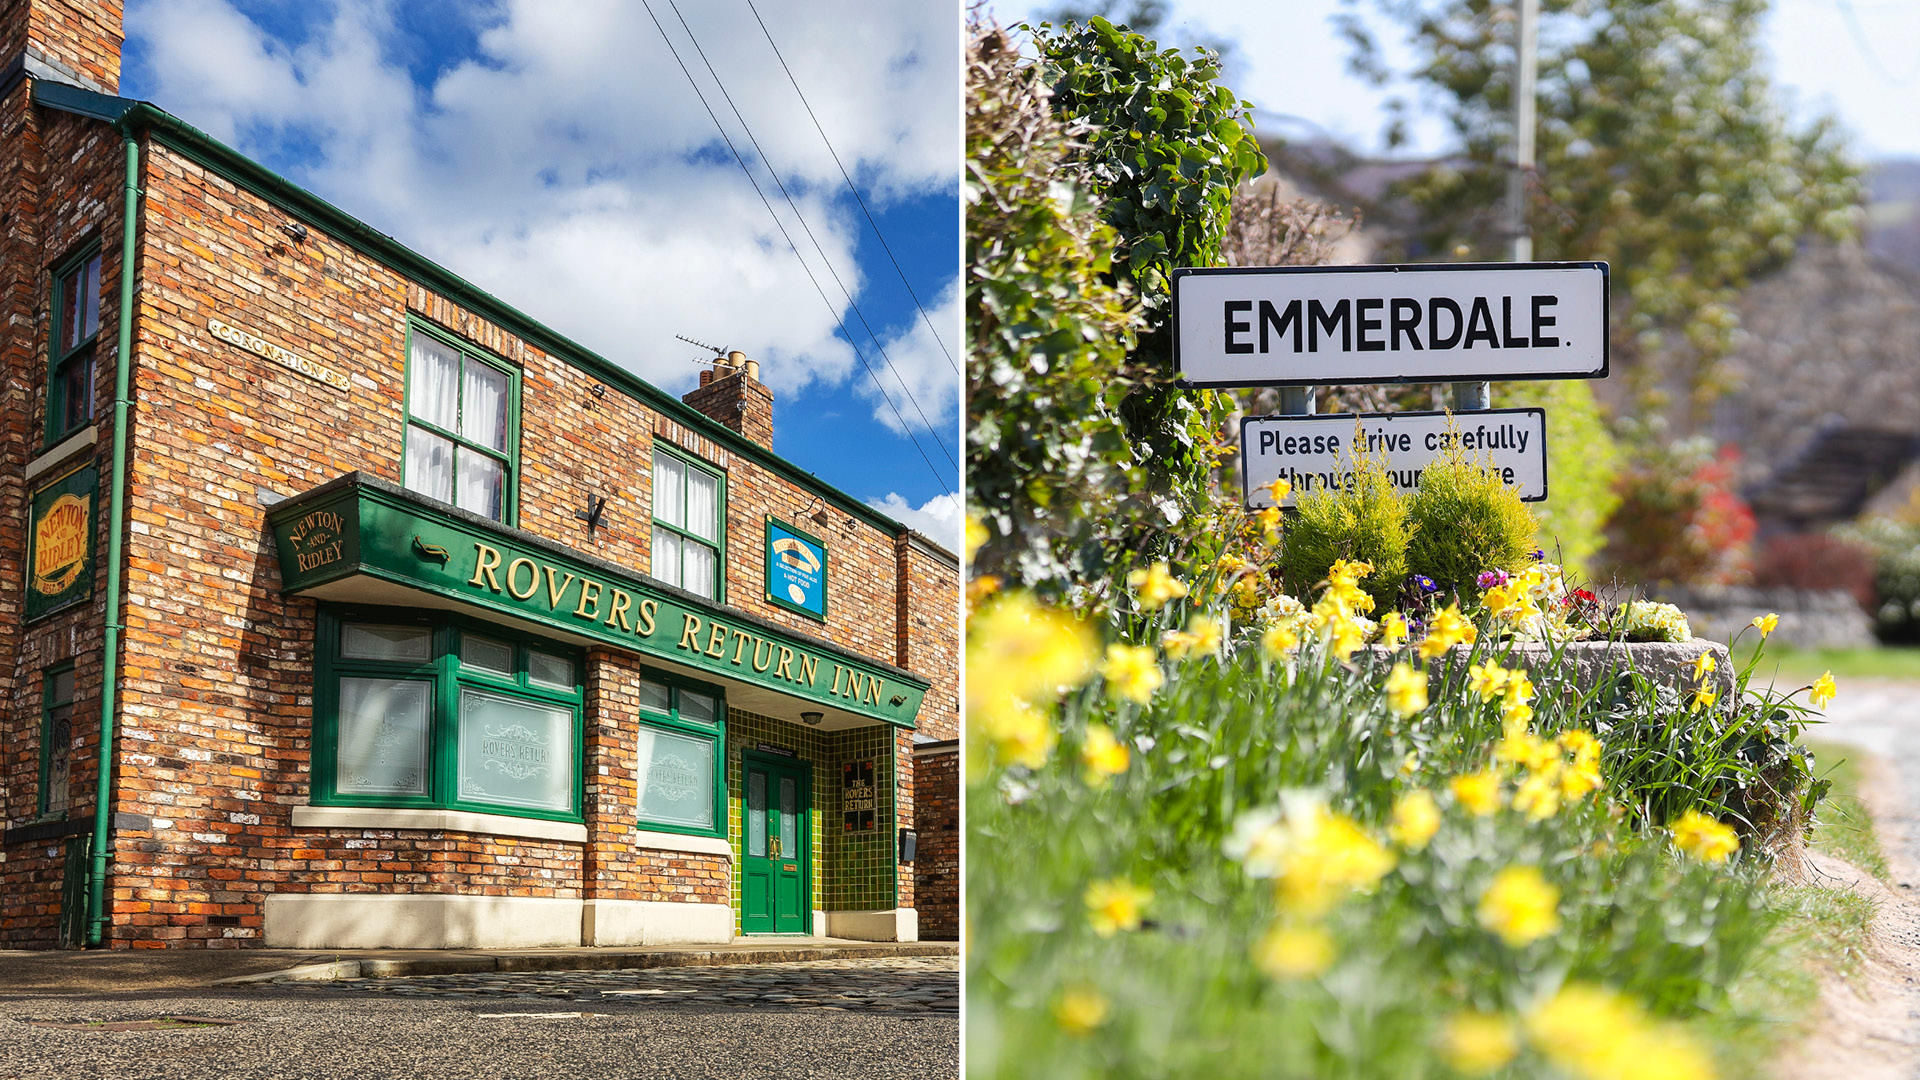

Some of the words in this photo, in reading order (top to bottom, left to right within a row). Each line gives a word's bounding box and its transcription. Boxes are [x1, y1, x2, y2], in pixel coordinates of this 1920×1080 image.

[220, 325, 321, 378] CORONATION
[1260, 430, 1340, 456] Please
[1278, 467, 1372, 495] throug
[1386, 469, 1423, 488] our
[39, 504, 86, 548] NEWTON
[289, 511, 344, 551] NEWTON
[39, 530, 84, 573] RIDLEY
[297, 540, 343, 573] RIDLEY
[787, 574, 797, 583] HOT
[798, 577, 810, 588] FOOD
[468, 542, 658, 637] ROVERS
[677, 612, 820, 688] RETURN
[829, 664, 885, 707] INN
[483, 740, 516, 758] ROVERS
[844, 787, 873, 799] ROVERS
[852, 779, 865, 787] THE
[844, 799, 873, 810] RETURN
